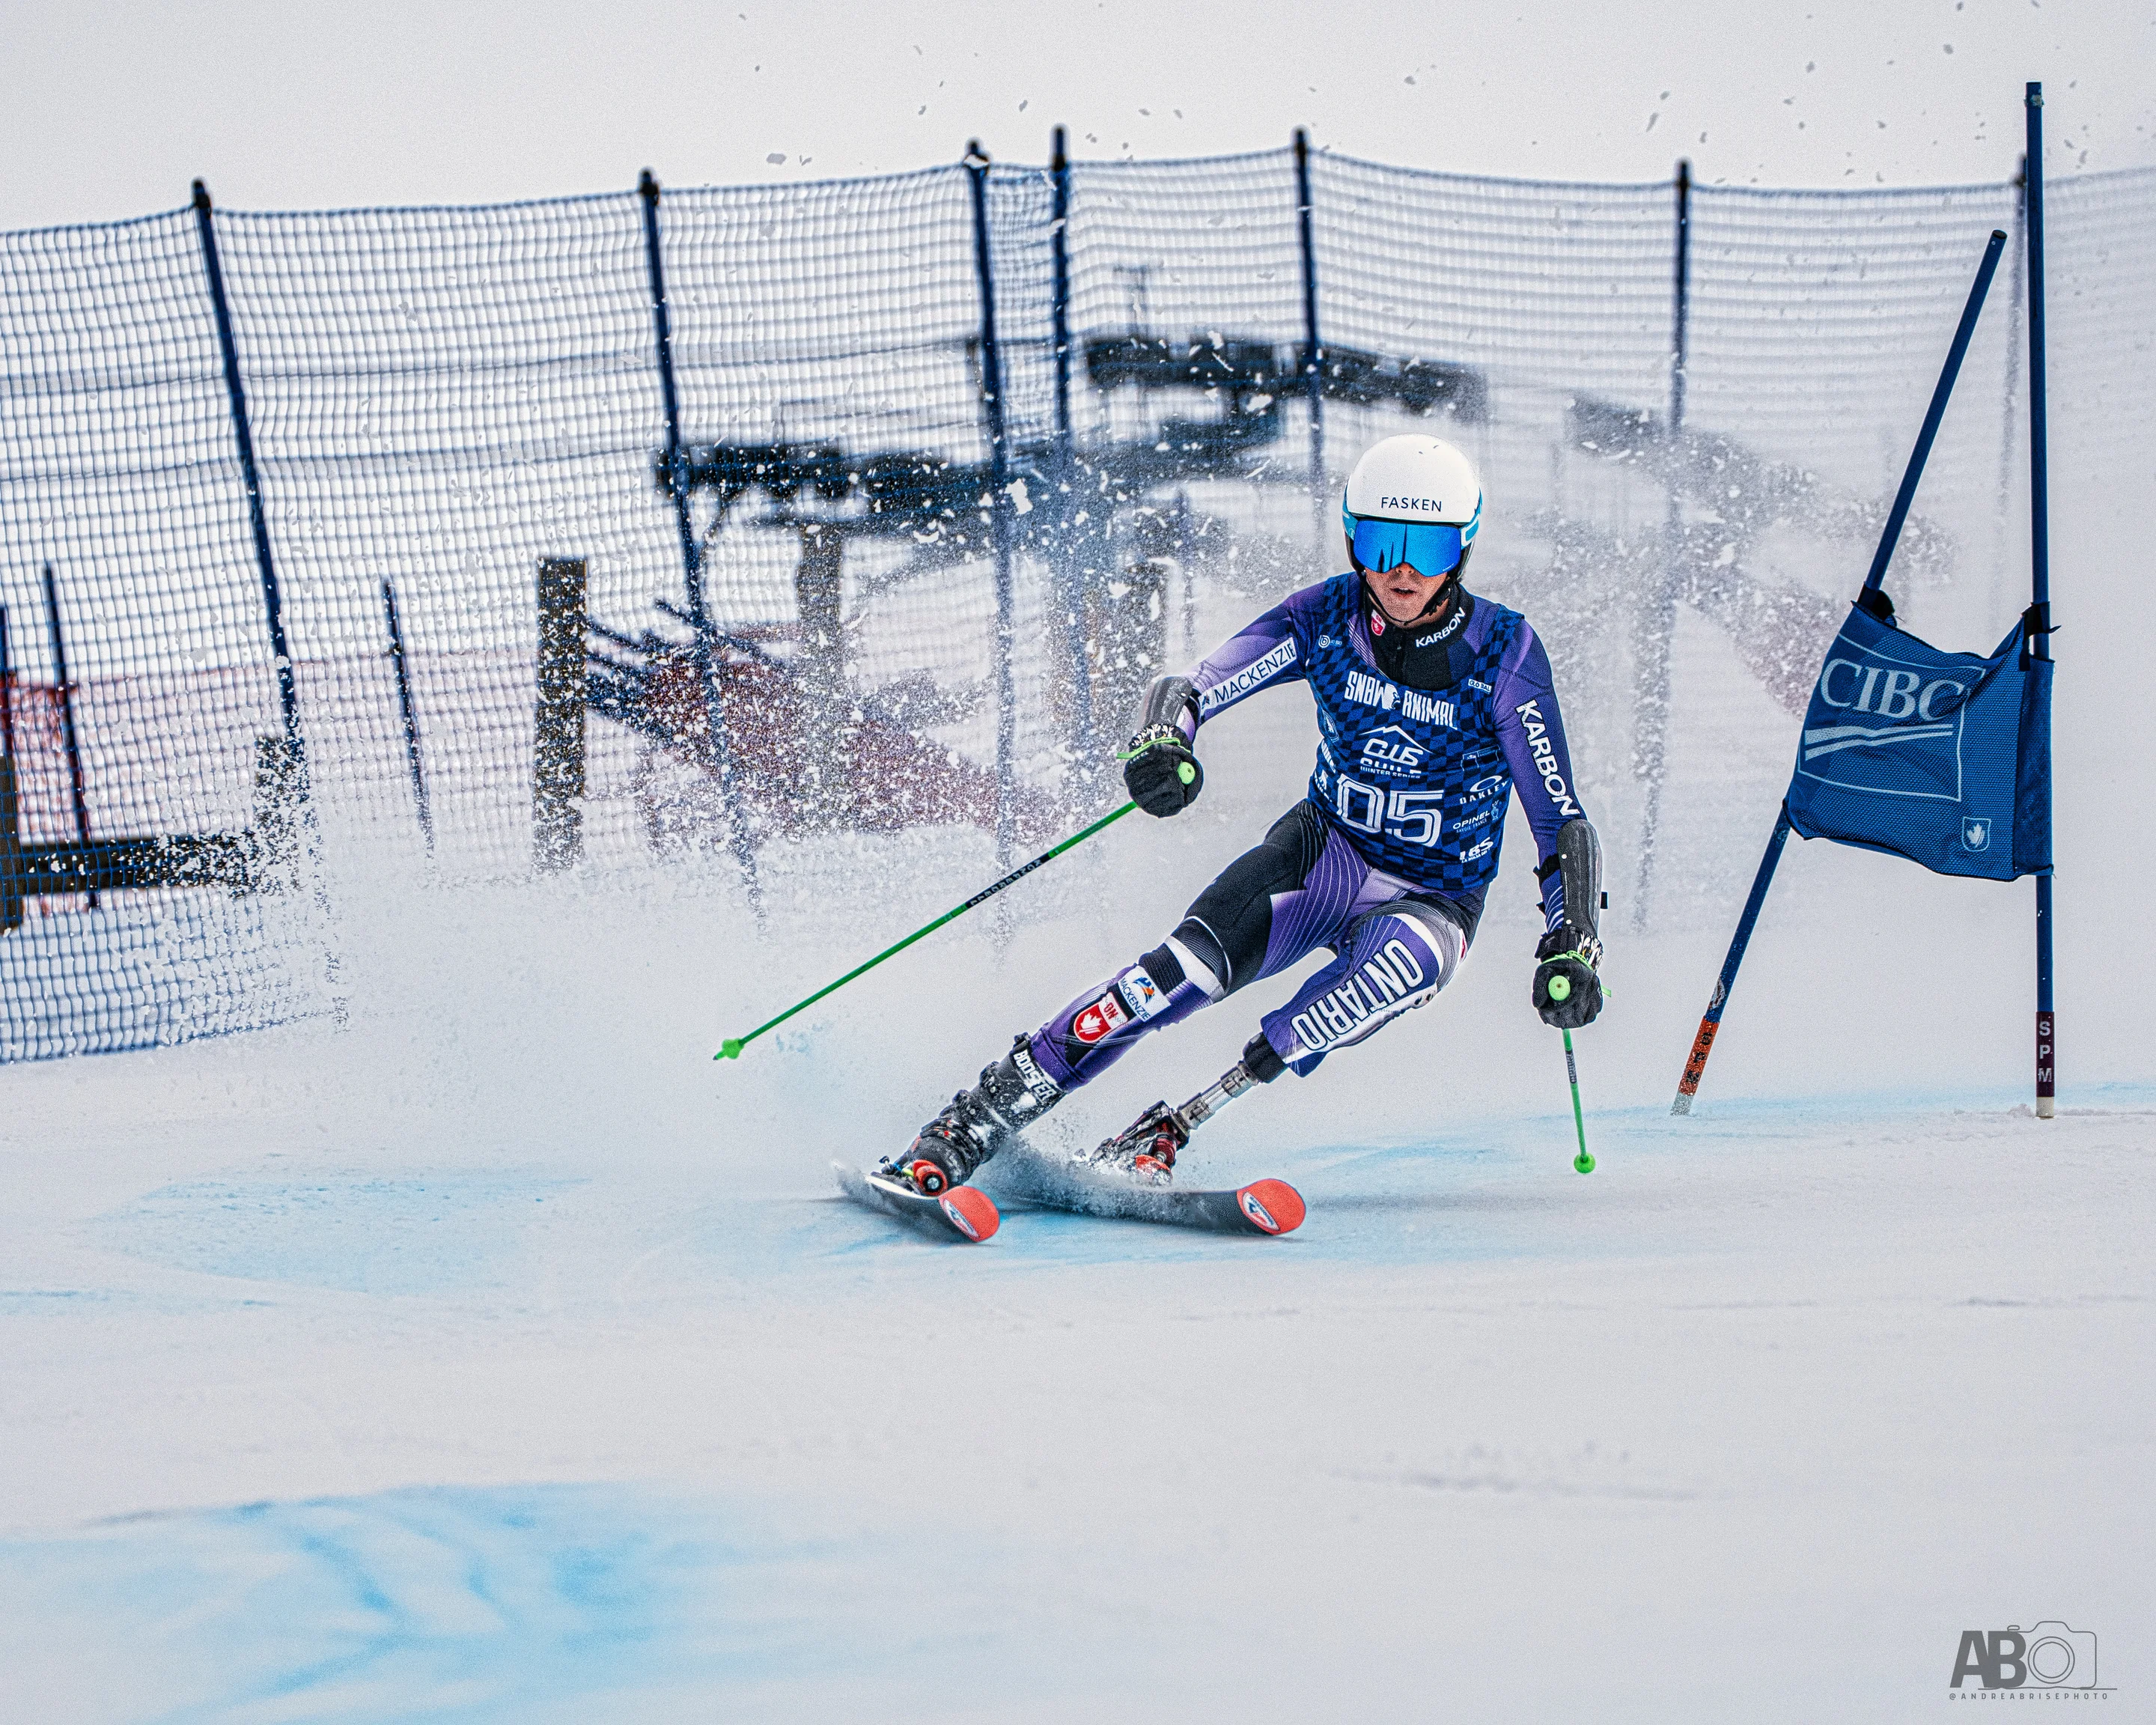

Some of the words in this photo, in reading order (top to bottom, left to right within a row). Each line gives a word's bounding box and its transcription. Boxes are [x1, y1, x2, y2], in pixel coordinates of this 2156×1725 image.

[1380, 496, 1442, 512] FASKEN
[1416, 606, 1465, 648] KARBON
[1213, 643, 1296, 703] MACKENZIE
[1345, 671, 1388, 710] SNOW
[1402, 690, 1458, 730] ANIMAL
[1821, 657, 1963, 722] CIBC
[1515, 699, 1580, 816] KARBON
[1336, 773, 1444, 848] 05
[1460, 780, 1508, 804] OAKLEY
[1453, 811, 1490, 830] OPINEL
[1103, 1003, 1118, 1020] ON
[1120, 977, 1151, 1020] MACKENZIE
[1291, 938, 1424, 1050] ONTARIO
[1013, 1049, 1057, 1101] BOOSTER
[2038, 1020, 2053, 1083] SPM
